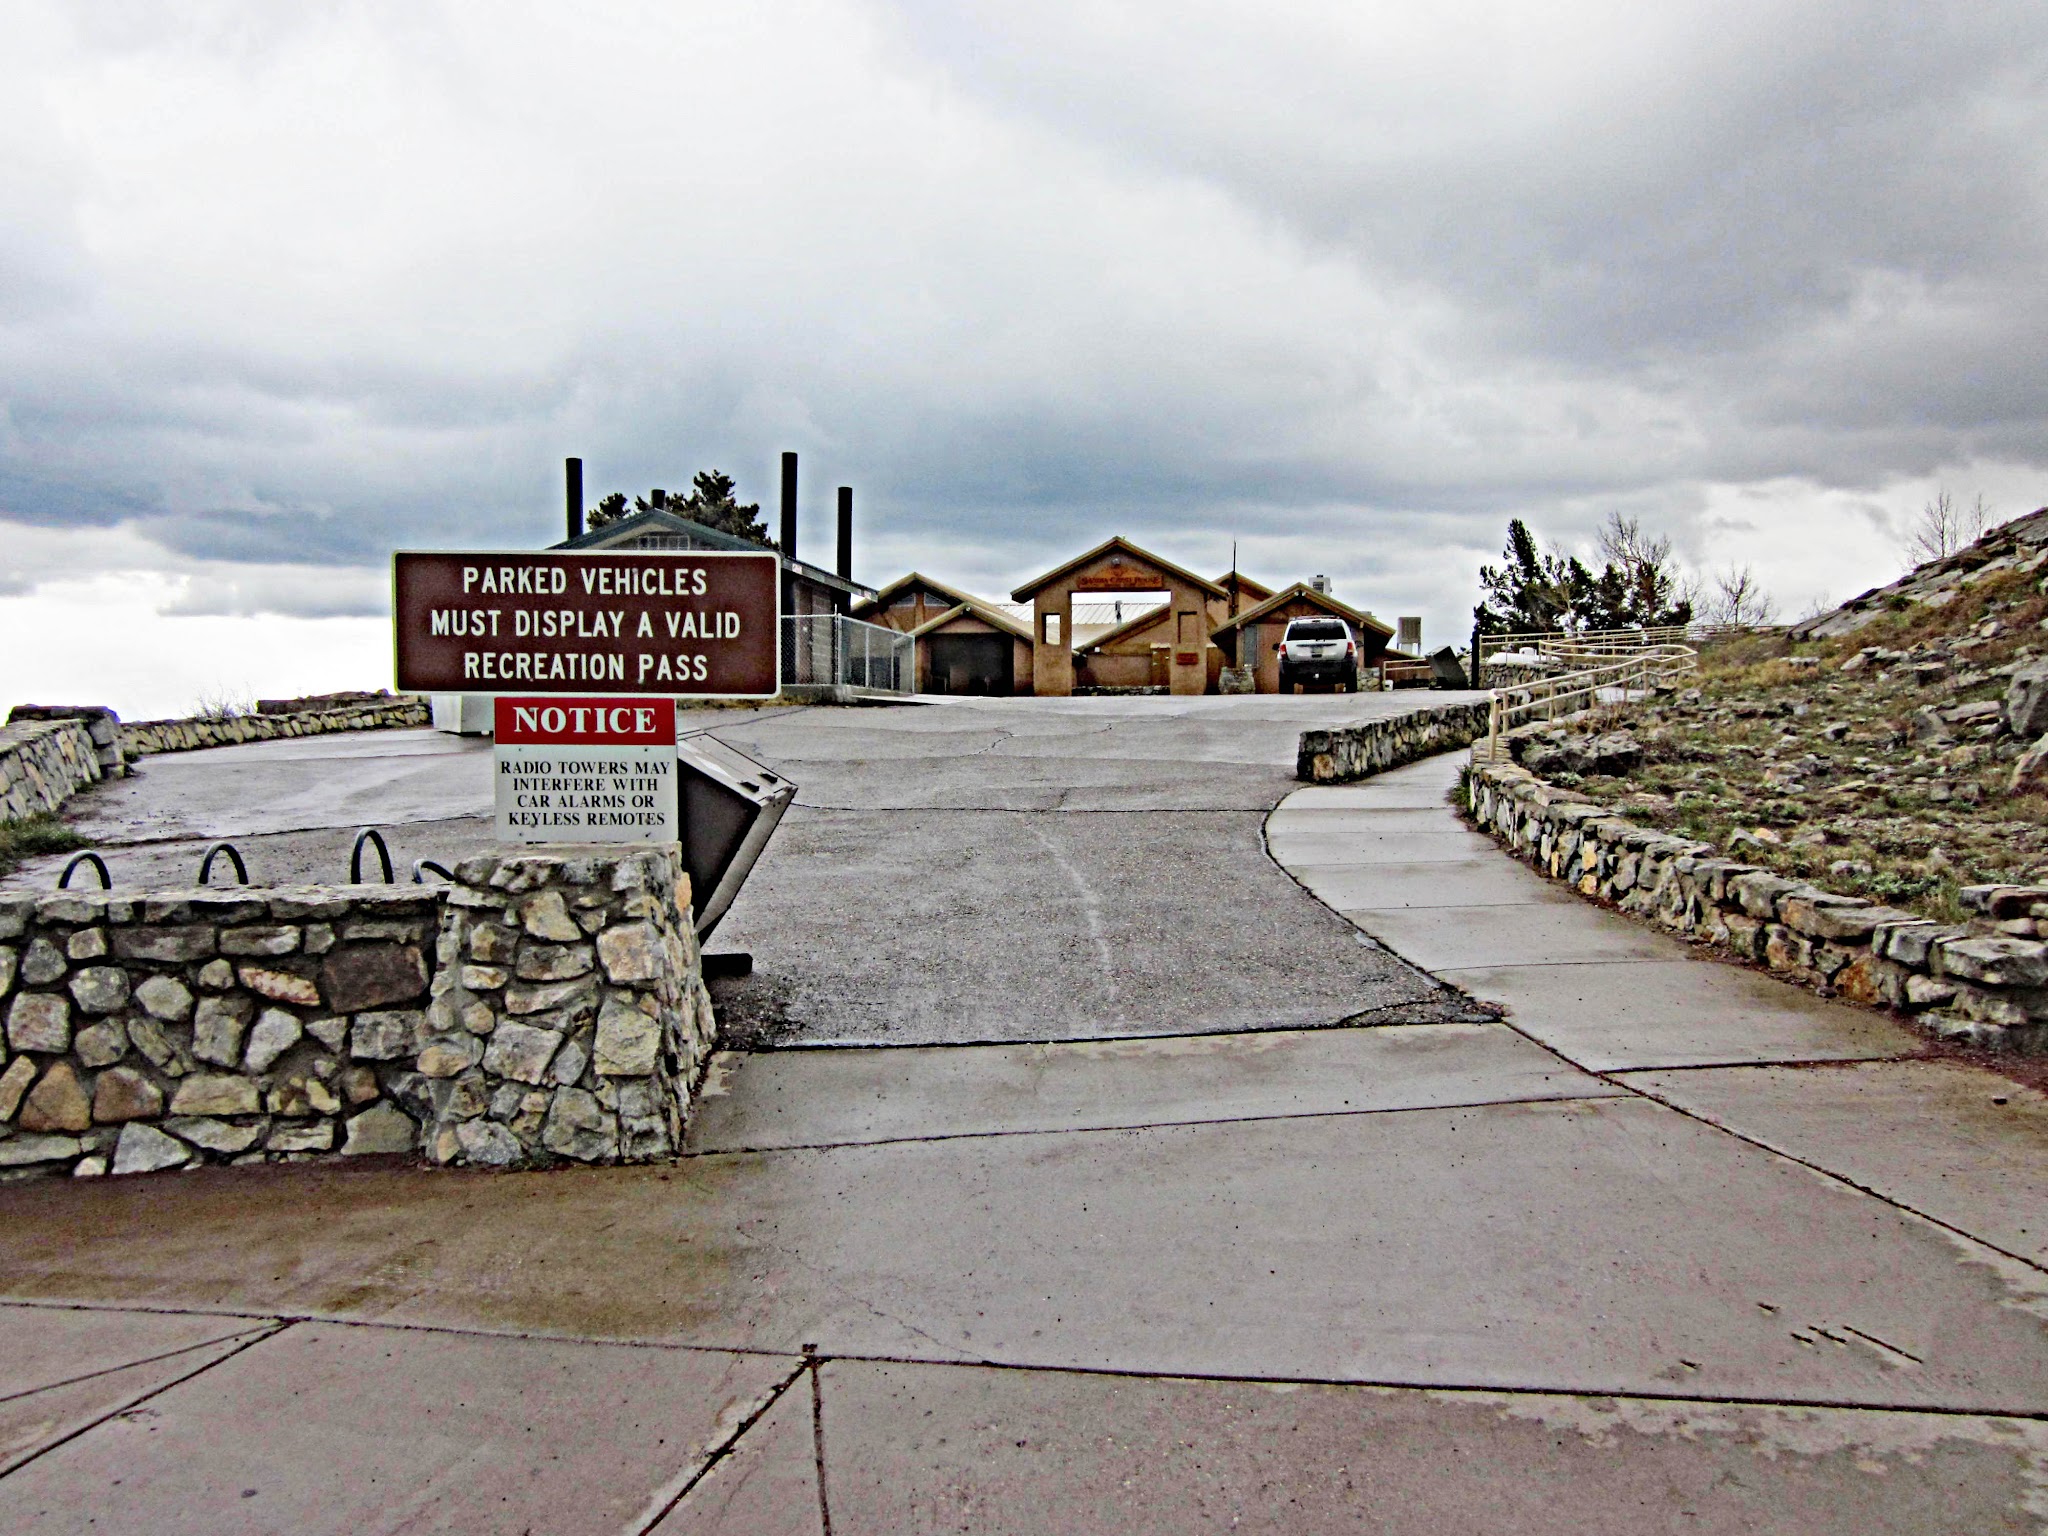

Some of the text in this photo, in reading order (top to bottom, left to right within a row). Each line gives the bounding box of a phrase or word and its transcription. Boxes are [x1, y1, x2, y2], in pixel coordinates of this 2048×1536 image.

[464, 567, 707, 595] PARKED VEHICLES
[431, 610, 741, 638] MUST DISPLAY A VALID
[465, 653, 708, 680] RECREATION PASS
[513, 707, 656, 733] NOTICE
[501, 761, 670, 774] RADIO TOWERS MAY
[513, 778, 658, 791] INTERFERE WITH
[517, 795, 655, 808] CAR ALARMS OR
[509, 813, 665, 826] KEYLESS REMOTES
